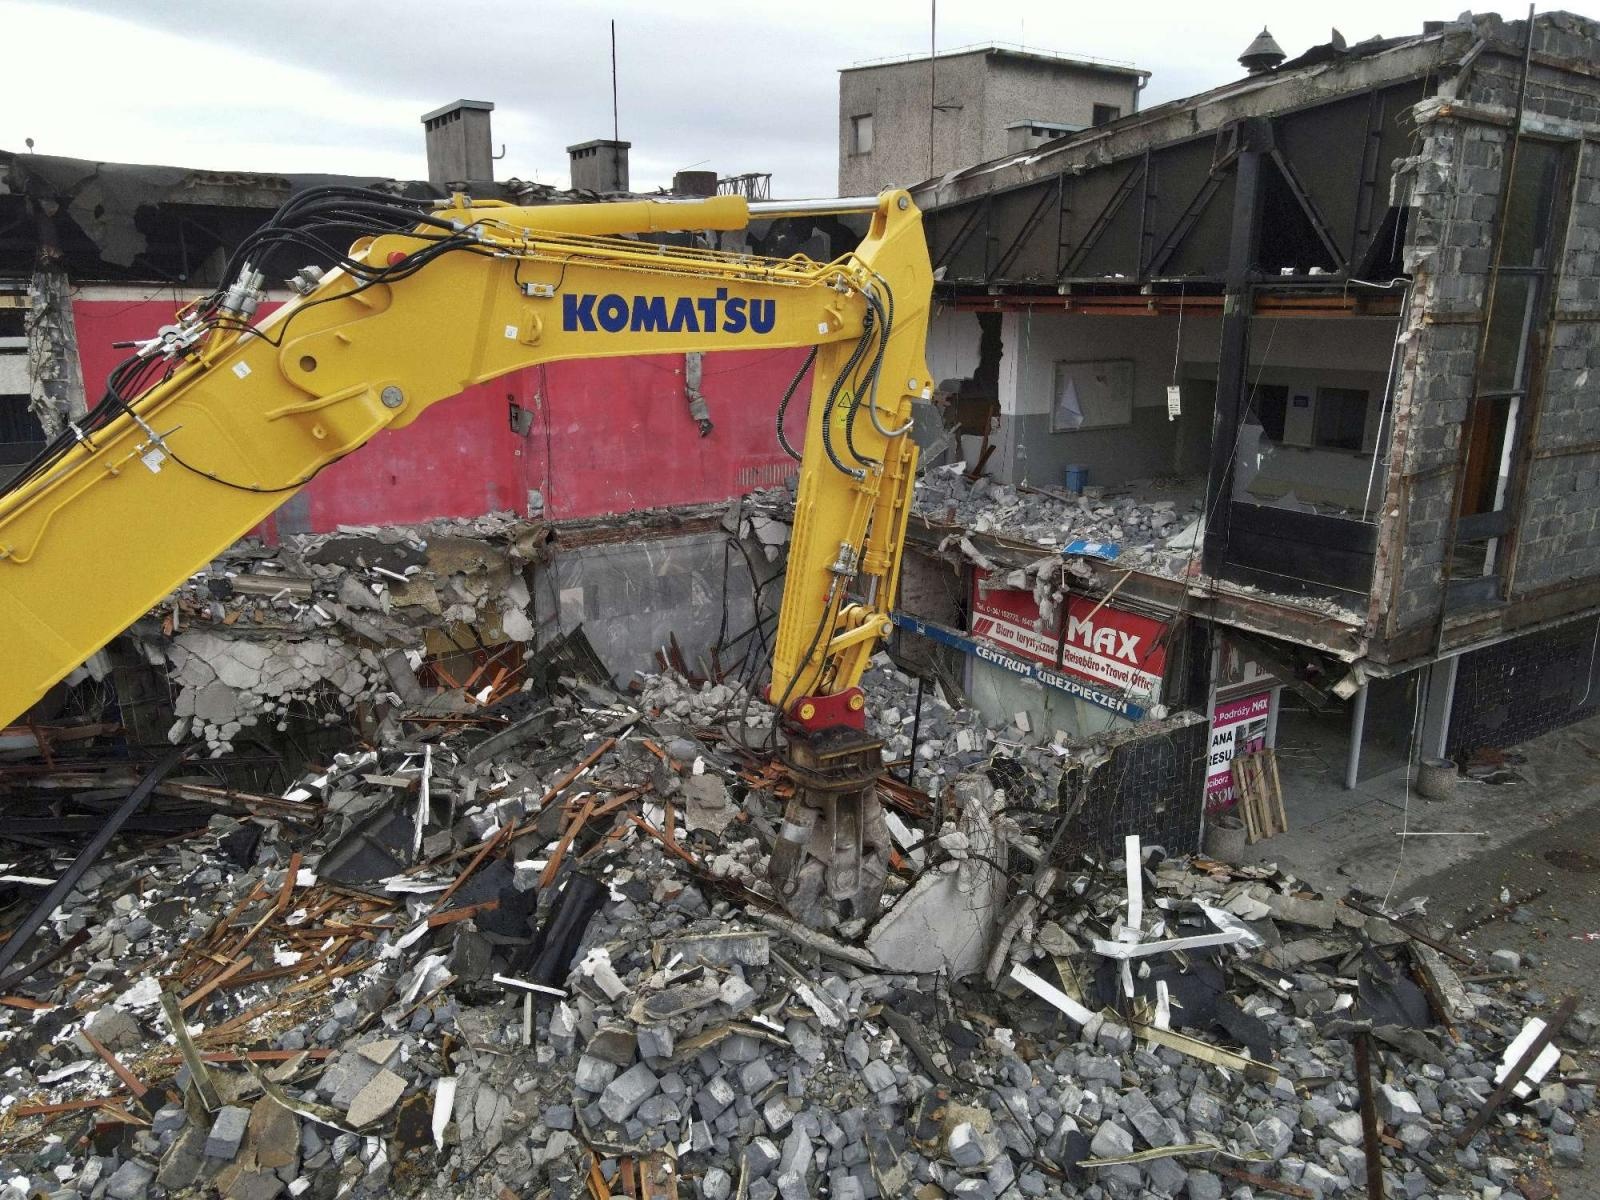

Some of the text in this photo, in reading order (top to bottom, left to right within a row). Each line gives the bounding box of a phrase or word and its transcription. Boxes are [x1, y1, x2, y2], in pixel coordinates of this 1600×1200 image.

[562, 288, 776, 334] KOMATSU
[995, 622, 1015, 638] Biuro
[1067, 615, 1142, 664] MAX
[975, 646, 1031, 676] CENTRUM
[1064, 649, 1100, 672] Reisebüro
[1105, 664, 1129, 682] Travel
[1219, 705, 1250, 721] Podróży
[1251, 698, 1268, 712] MAX
